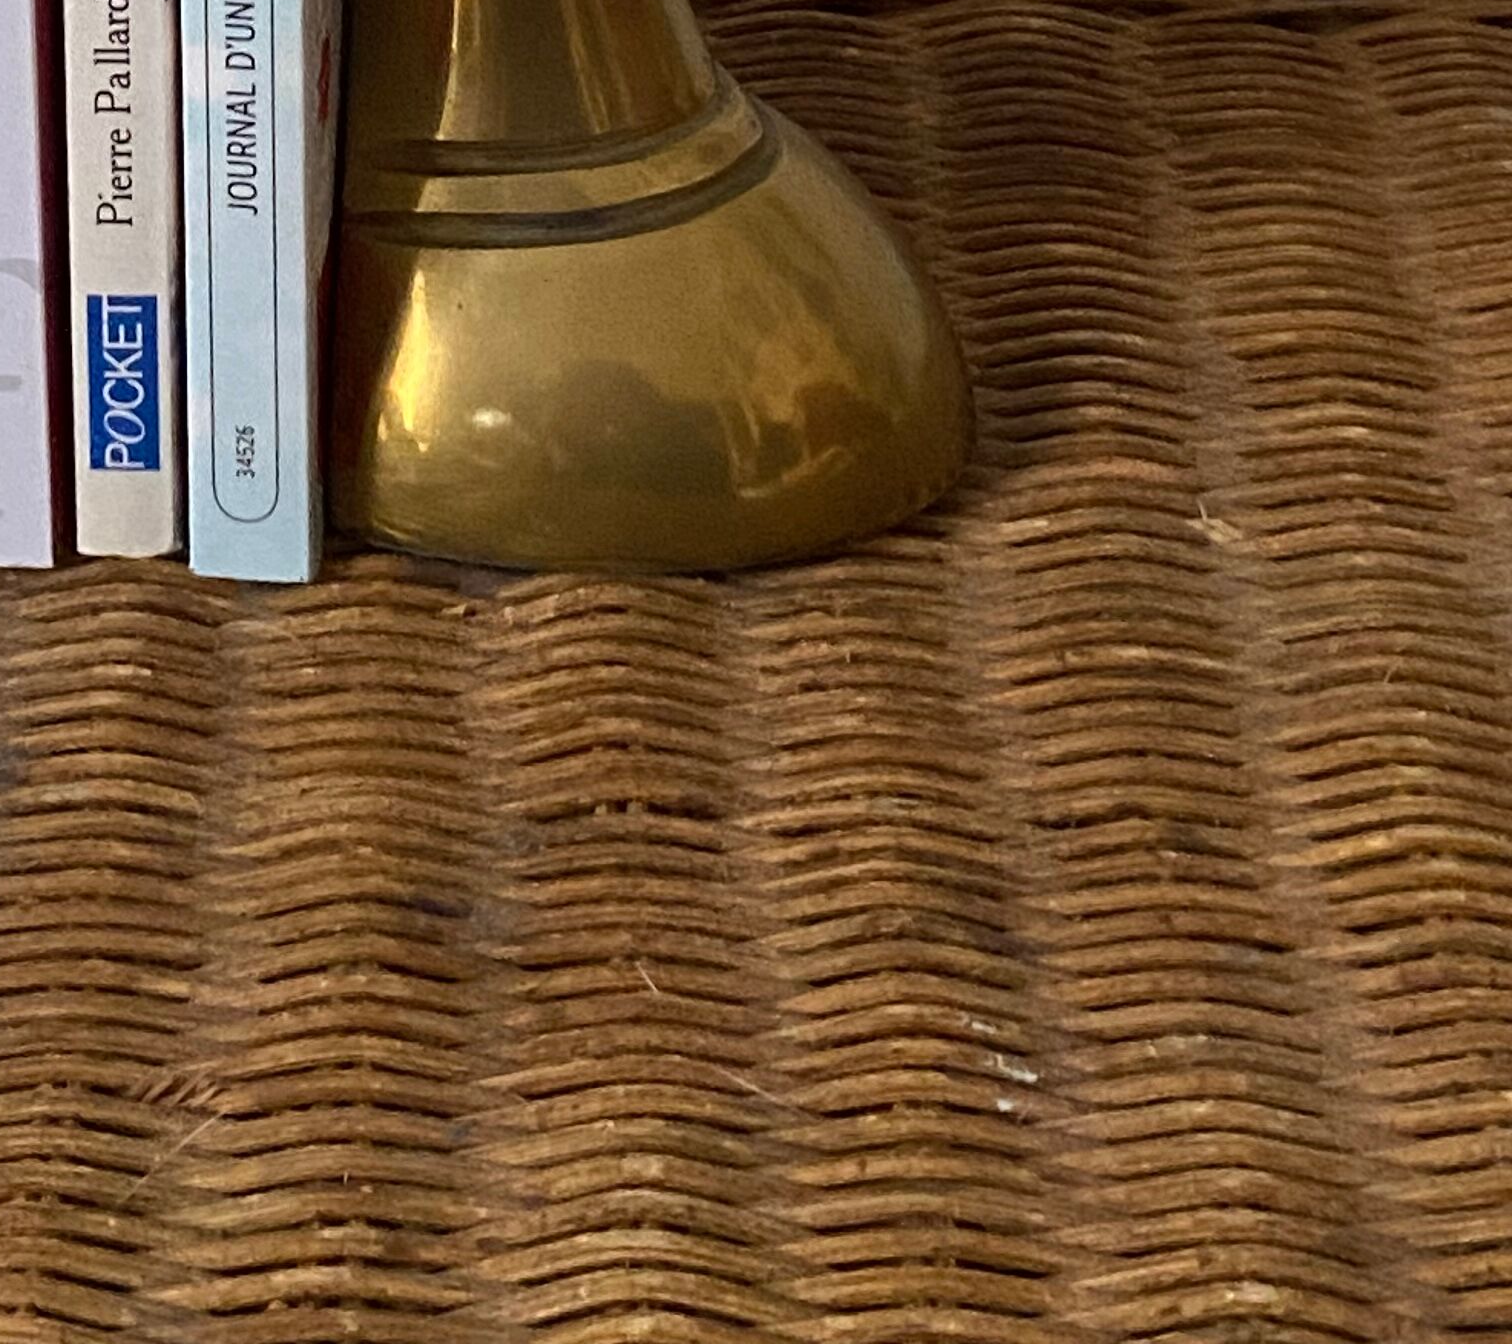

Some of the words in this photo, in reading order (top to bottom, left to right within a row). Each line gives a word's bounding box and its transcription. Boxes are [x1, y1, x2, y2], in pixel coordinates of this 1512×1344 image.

[224, 2, 256, 72] D'UN
[96, 127, 134, 228] Pierre
[226, 82, 259, 216] JOURNAL
[101, 295, 146, 470] POCKET
[235, 425, 255, 479] 34526
